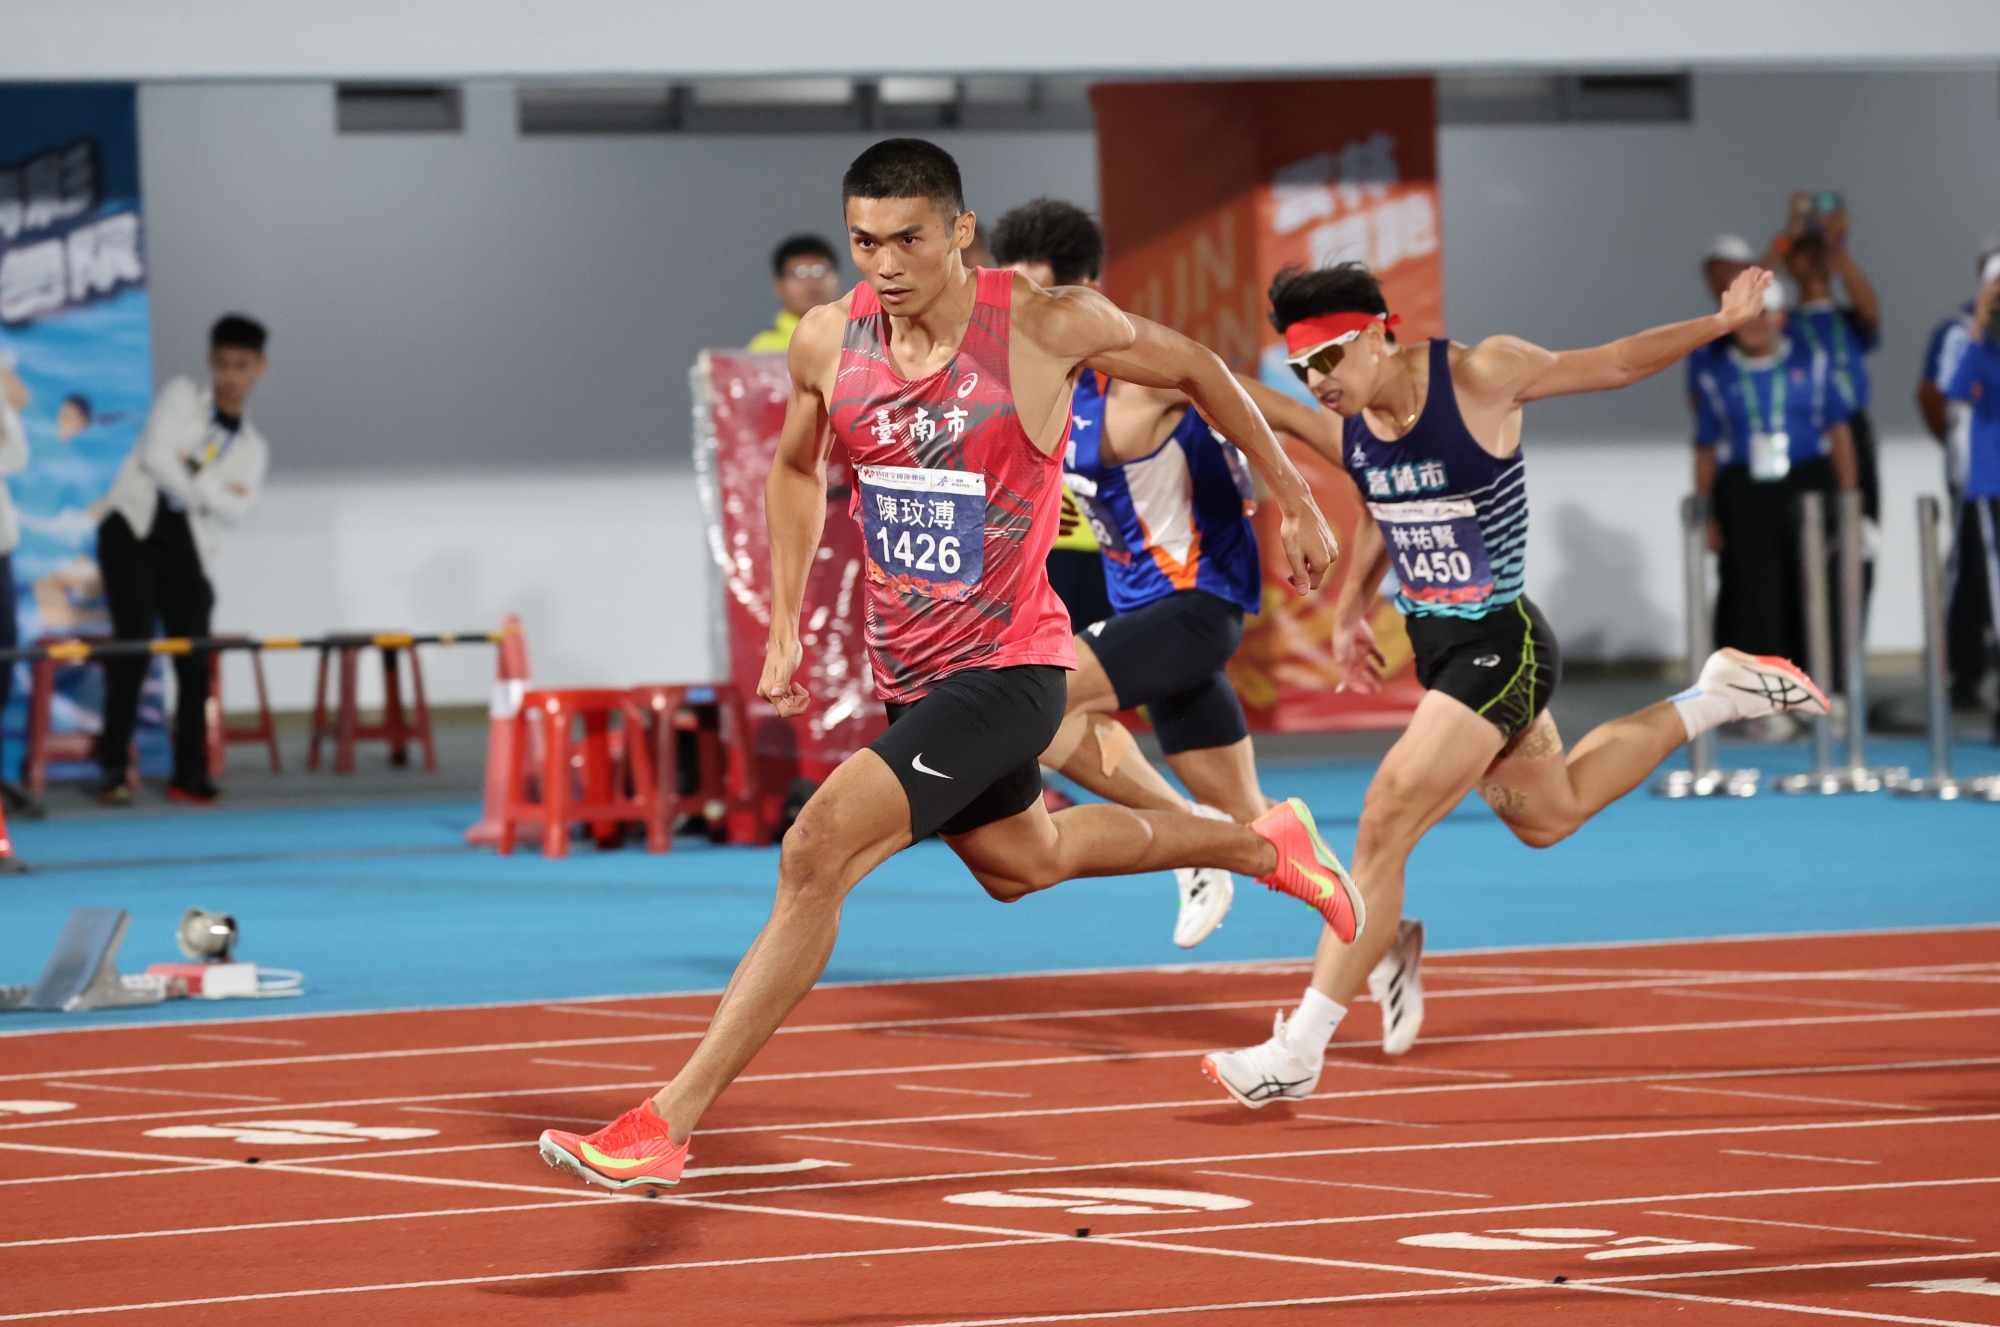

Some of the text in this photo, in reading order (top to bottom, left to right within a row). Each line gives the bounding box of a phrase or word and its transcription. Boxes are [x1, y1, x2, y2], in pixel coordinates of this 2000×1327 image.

[870, 404, 968, 446] 臺南市
[1365, 460, 1447, 496] 高雄市
[875, 493, 956, 530] 陳玟溥
[876, 526, 961, 574] 1426
[1390, 524, 1459, 551] 林祐賢
[1398, 550, 1472, 583] 1450
